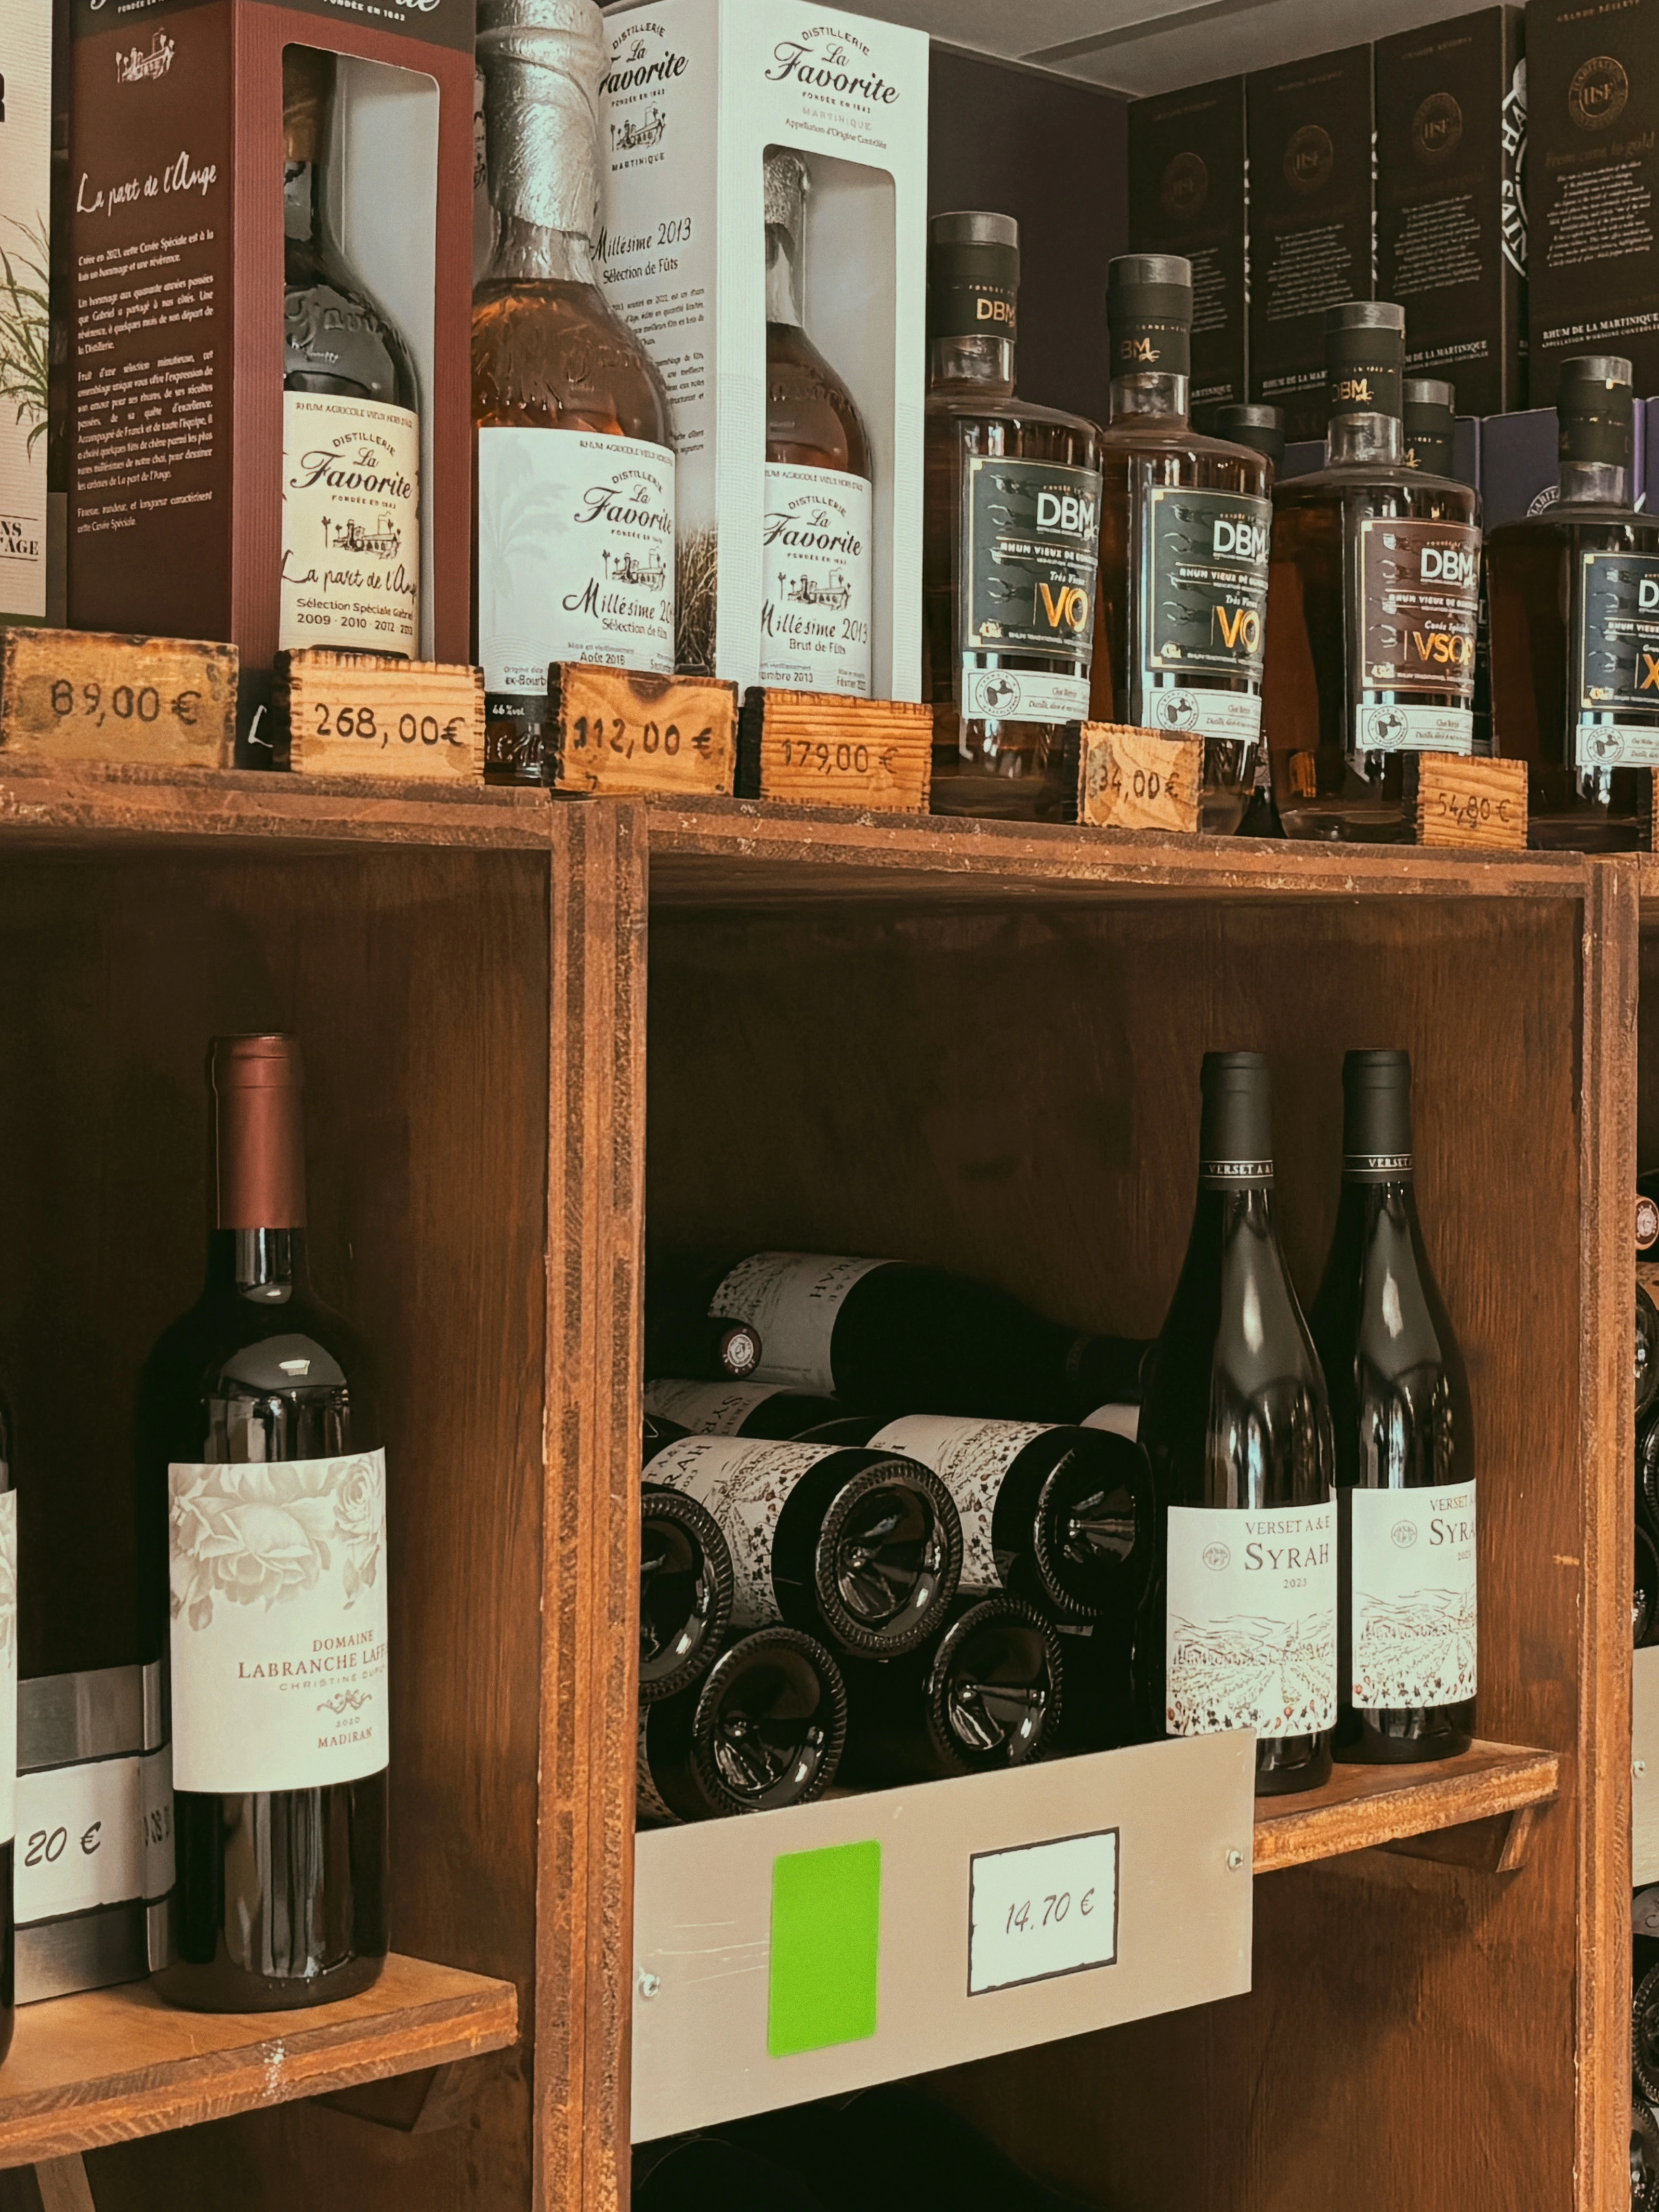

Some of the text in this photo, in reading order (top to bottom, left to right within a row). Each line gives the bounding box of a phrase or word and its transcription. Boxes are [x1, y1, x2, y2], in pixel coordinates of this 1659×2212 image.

[612, 22, 666, 50] DISTILLERIE
[801, 27, 870, 56] DISTILLERIE
[626, 39, 649, 63] La
[821, 43, 850, 67] La
[598, 50, 689, 97] avorite
[765, 41, 900, 104] Favorite
[802, 106, 873, 131] MARTINIQUE
[611, 152, 666, 172] MARTINIQUE
[76, 151, 217, 217] La part de l'Ange
[590, 217, 692, 264] Millésime 2013
[603, 258, 679, 284] Sélection de Fûts
[977, 298, 1016, 322] DBM
[1543, 312, 1659, 339] RHUM DE LA MARTINIQUE
[1120, 337, 1152, 360] BM
[1437, 339, 1487, 357] MARTINIQUE
[333, 432, 396, 457] DISTILLERIE
[353, 447, 379, 468] La
[290, 451, 413, 499] Favorite
[332, 495, 366, 505] FONDÉE
[628, 483, 652, 504] La
[788, 495, 847, 518] DISTILLERIE
[807, 508, 832, 528] La
[1036, 492, 1095, 533] DBM
[763, 512, 863, 557] Favorite
[1213, 519, 1266, 558] DBM
[1000, 542, 1032, 555] RHUM
[1034, 546, 1062, 559] VIEUX
[1064, 549, 1075, 561] DE
[282, 549, 382, 592] La part de
[1179, 567, 1208, 579] RHUM
[1211, 571, 1236, 583] VIEUX
[1420, 548, 1474, 581] DBM
[297, 597, 392, 617] Sélection Spéciale
[562, 576, 656, 620] Millésime
[1038, 582, 1089, 633] VO
[1389, 593, 1417, 604] RHUM
[1418, 595, 1444, 606] VIEUX
[297, 613, 396, 632] 2009 2010 2012
[601, 617, 646, 635] Sélection
[761, 598, 868, 644] Millésime 2013
[1216, 604, 1260, 654] VO
[789, 638, 812, 651] Brut
[814, 641, 828, 652] de
[52, 679, 203, 727] 89,00 €
[574, 715, 713, 760] 112,00 €
[782, 738, 899, 775] 179,00 €
[1437, 792, 1511, 825] 54,80 €
[1209, 1164, 1254, 1175] VERSET
[1430, 1495, 1468, 1512] VERSET
[1245, 1520, 1301, 1535] VERSET
[1429, 1518, 1476, 1546] SYRA
[1244, 1542, 1329, 1571] SYRAH
[1283, 1577, 1308, 1589] 2023
[312, 1629, 374, 1653] DOMAINE
[238, 1652, 358, 1679] LABRANCHE
[279, 1672, 358, 1691] CHRISTINE
[317, 1726, 373, 1749] MADIRAN
[24, 1826, 68, 1867] 20
[79, 1821, 102, 1855] €
[1006, 1887, 1095, 1934] 14.70 €
